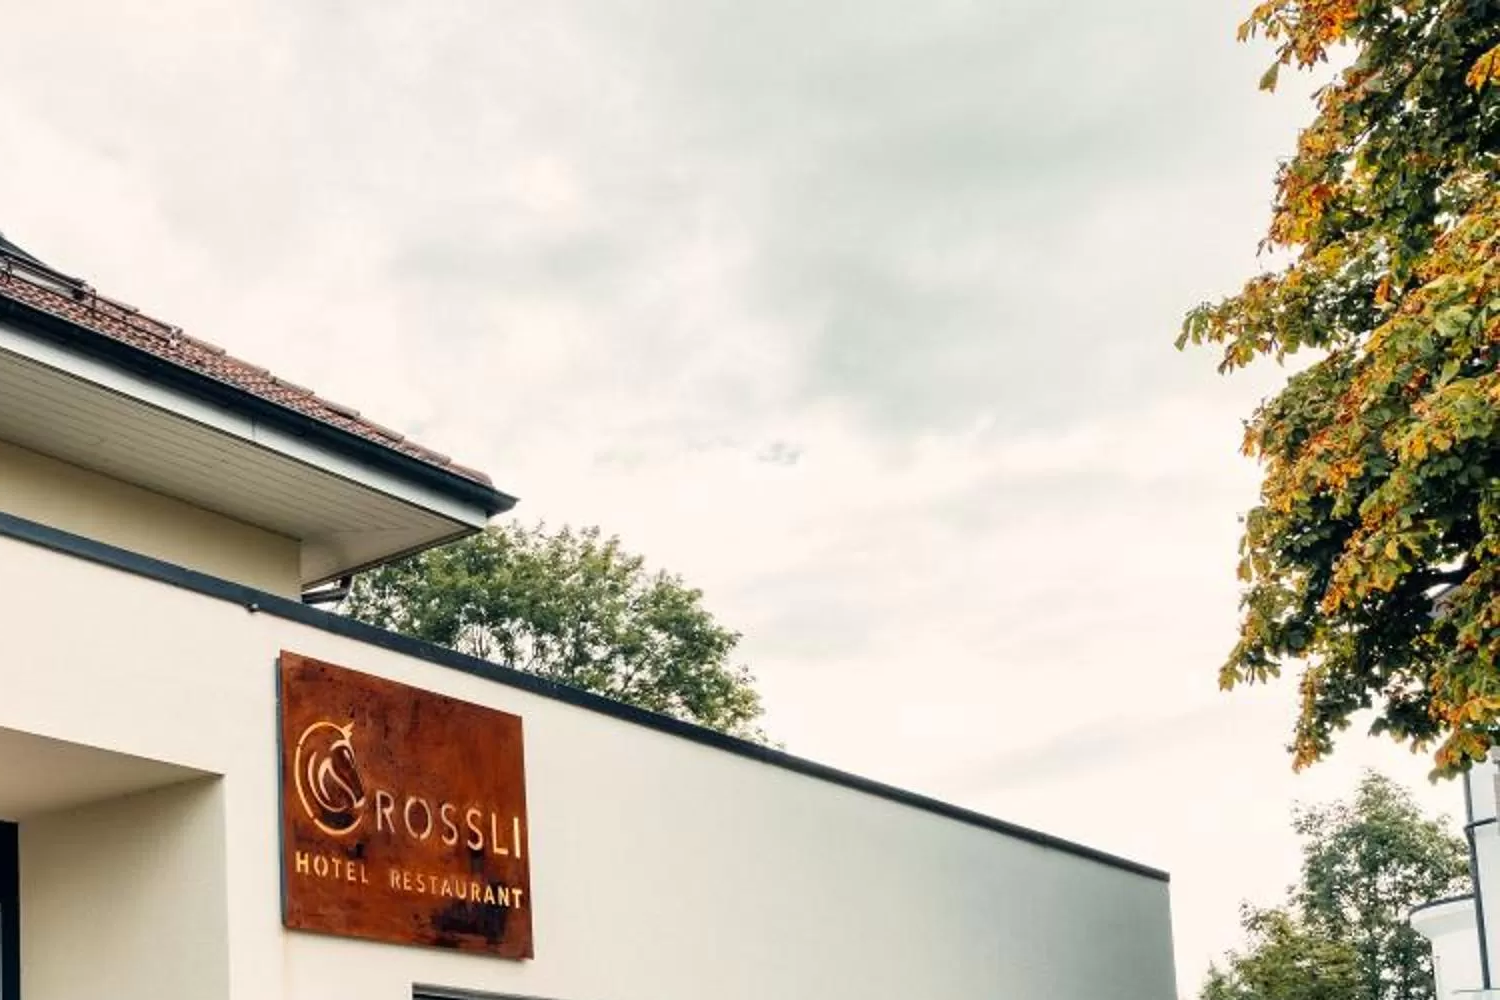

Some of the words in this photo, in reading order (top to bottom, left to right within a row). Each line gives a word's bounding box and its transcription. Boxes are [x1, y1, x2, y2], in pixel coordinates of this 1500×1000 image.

[376, 790, 522, 859] ROSSLI
[295, 851, 369, 883] HOTEL
[390, 869, 523, 909] RESTAURANT
